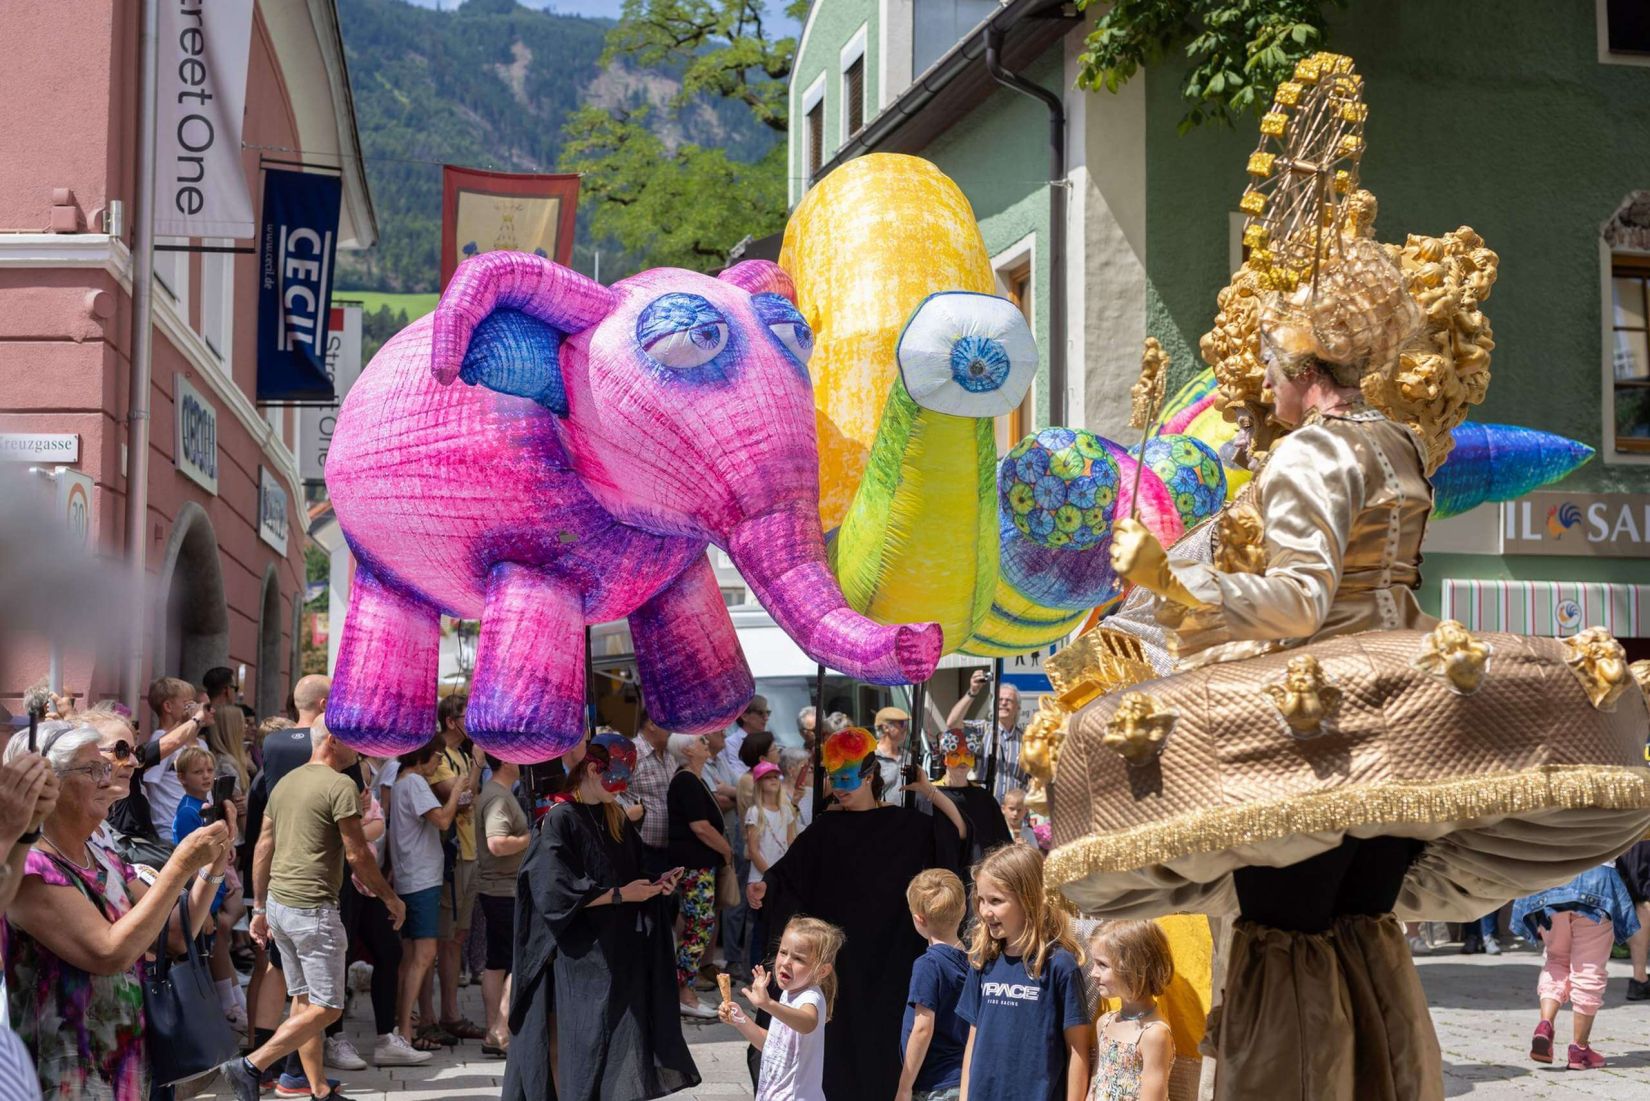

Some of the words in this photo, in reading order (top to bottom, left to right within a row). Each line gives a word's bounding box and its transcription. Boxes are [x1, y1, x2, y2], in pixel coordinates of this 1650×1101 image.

[178, 0, 213, 106] reet
[175, 113, 214, 216] One
[285, 227, 322, 352] CECIL
[0, 436, 72, 453] reuzgasse
[1505, 501, 1543, 540] IL
[1587, 502, 1650, 543] SA
[980, 982, 1041, 1001] PACE
